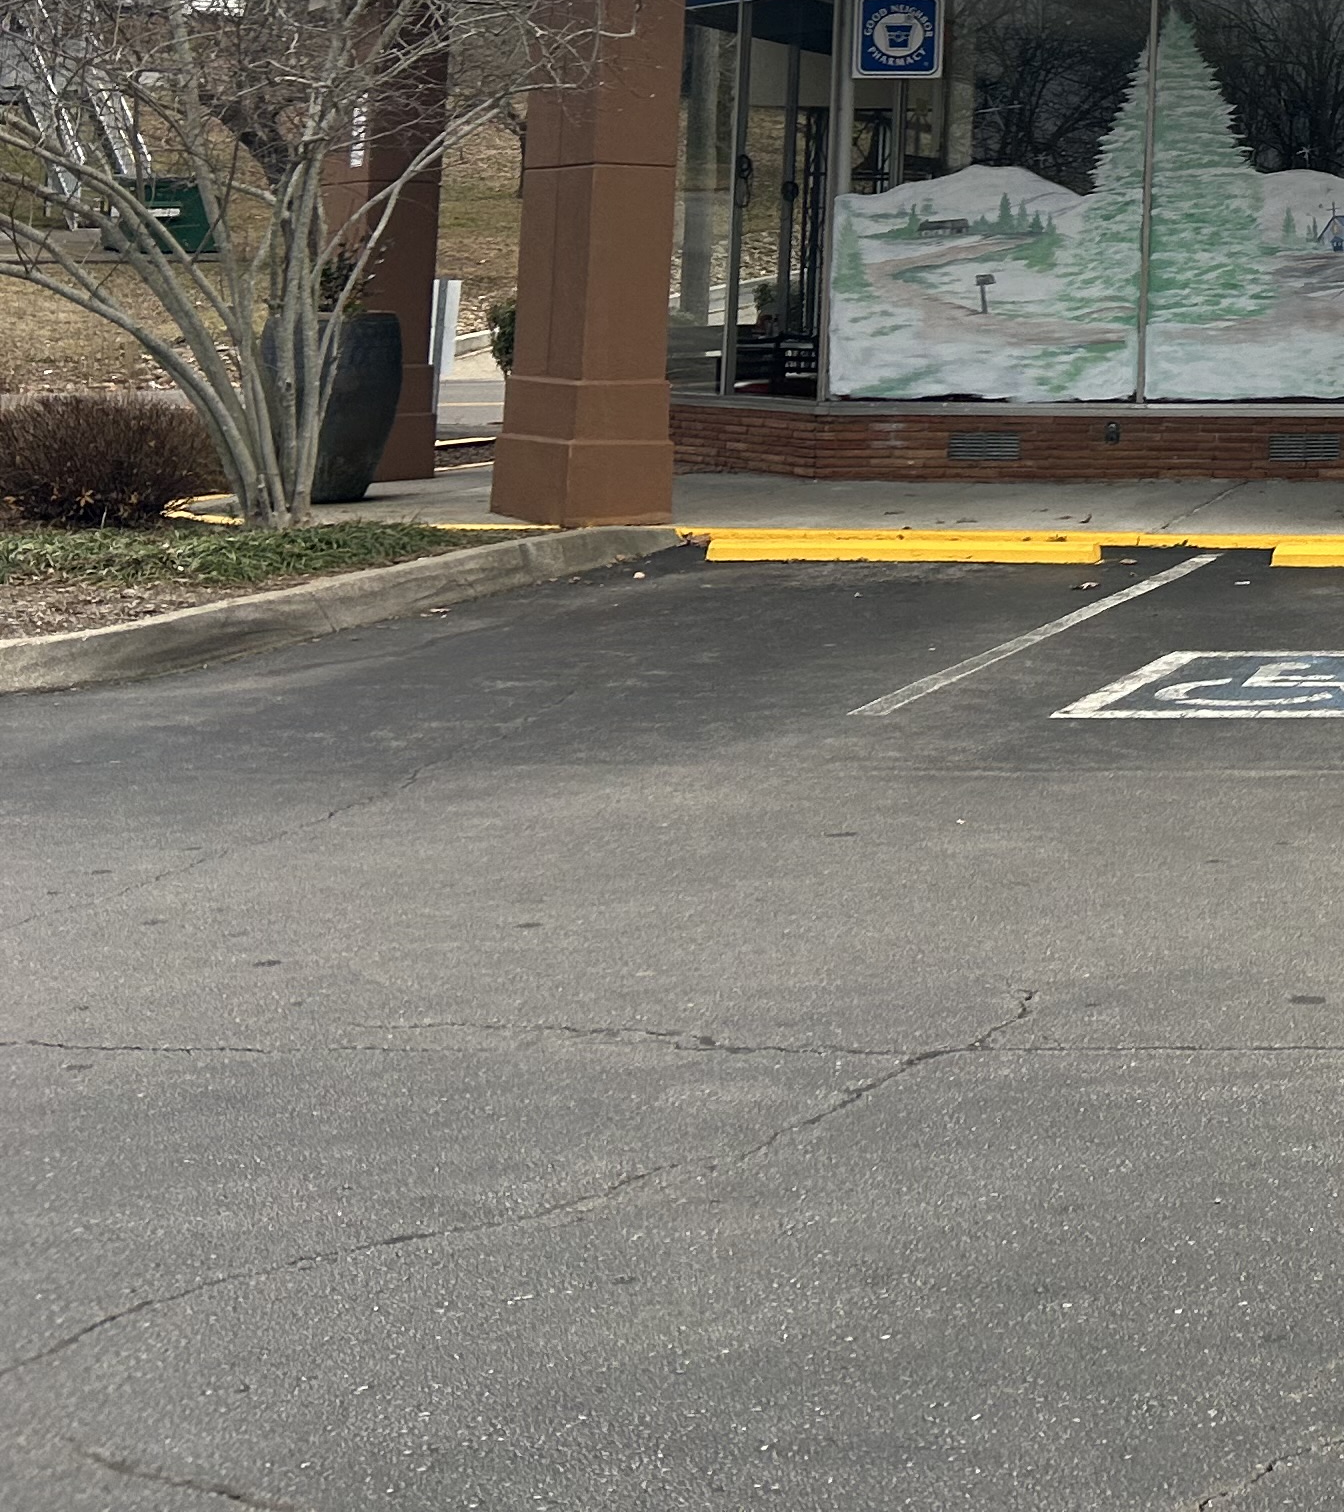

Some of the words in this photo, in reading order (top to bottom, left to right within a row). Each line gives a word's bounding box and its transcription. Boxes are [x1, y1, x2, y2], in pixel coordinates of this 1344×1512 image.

[863, 8, 888, 36] GOOD
[890, 4, 934, 38] NEIGHBOR
[867, 46, 926, 66] PHARMACY
